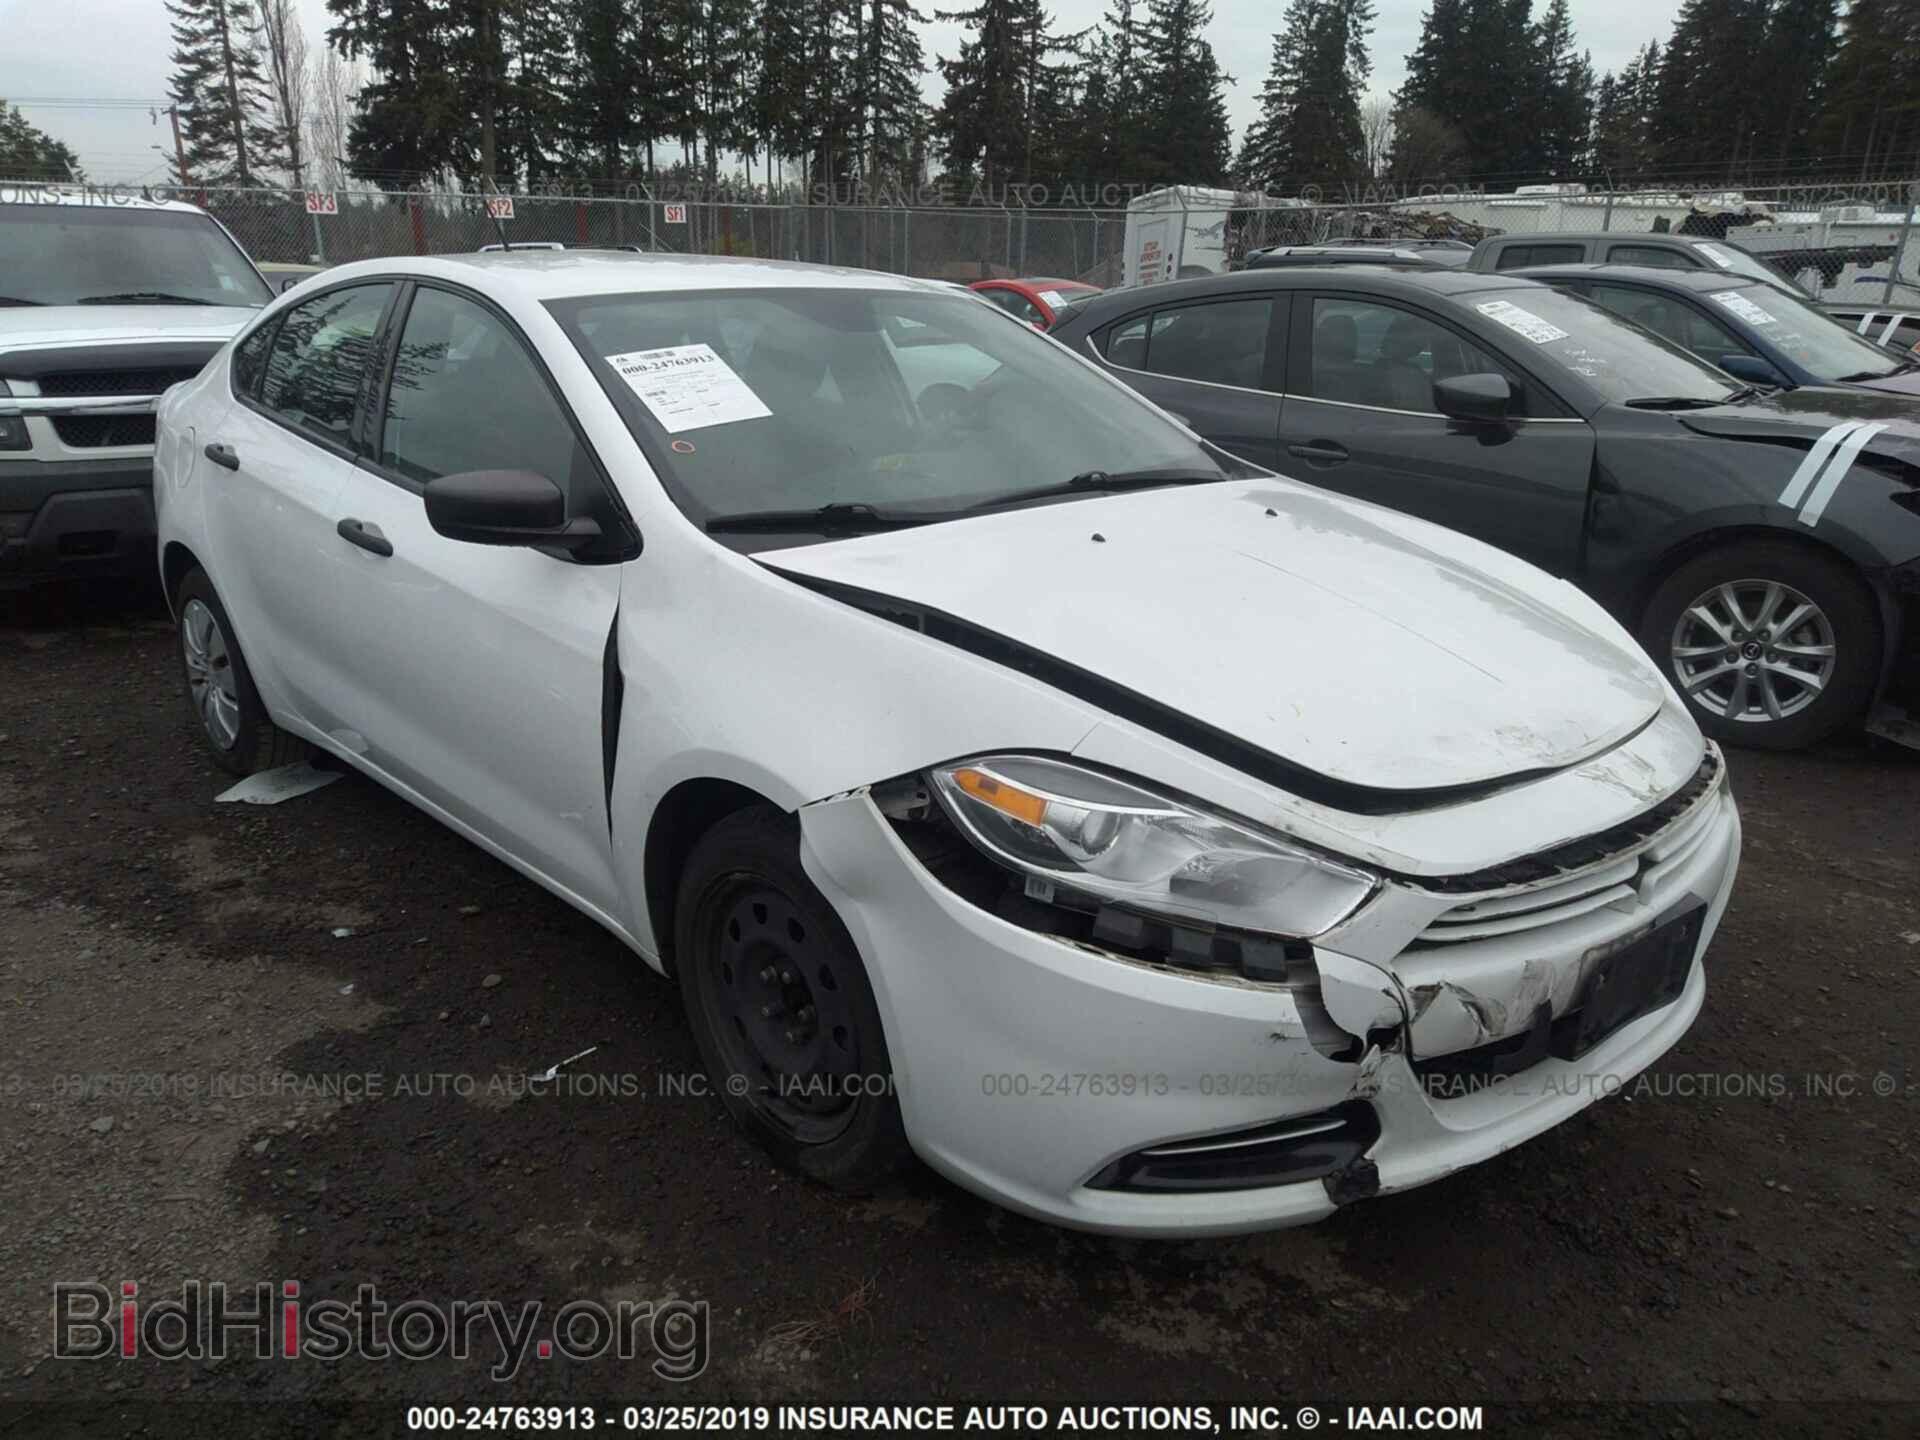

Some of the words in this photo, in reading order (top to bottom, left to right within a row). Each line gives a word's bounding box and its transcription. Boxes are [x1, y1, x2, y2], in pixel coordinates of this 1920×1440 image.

[308, 192, 336, 212] SF3
[488, 200, 513, 217] SF2
[666, 206, 684, 221] SF1
[622, 354, 715, 376] 000-24763913
